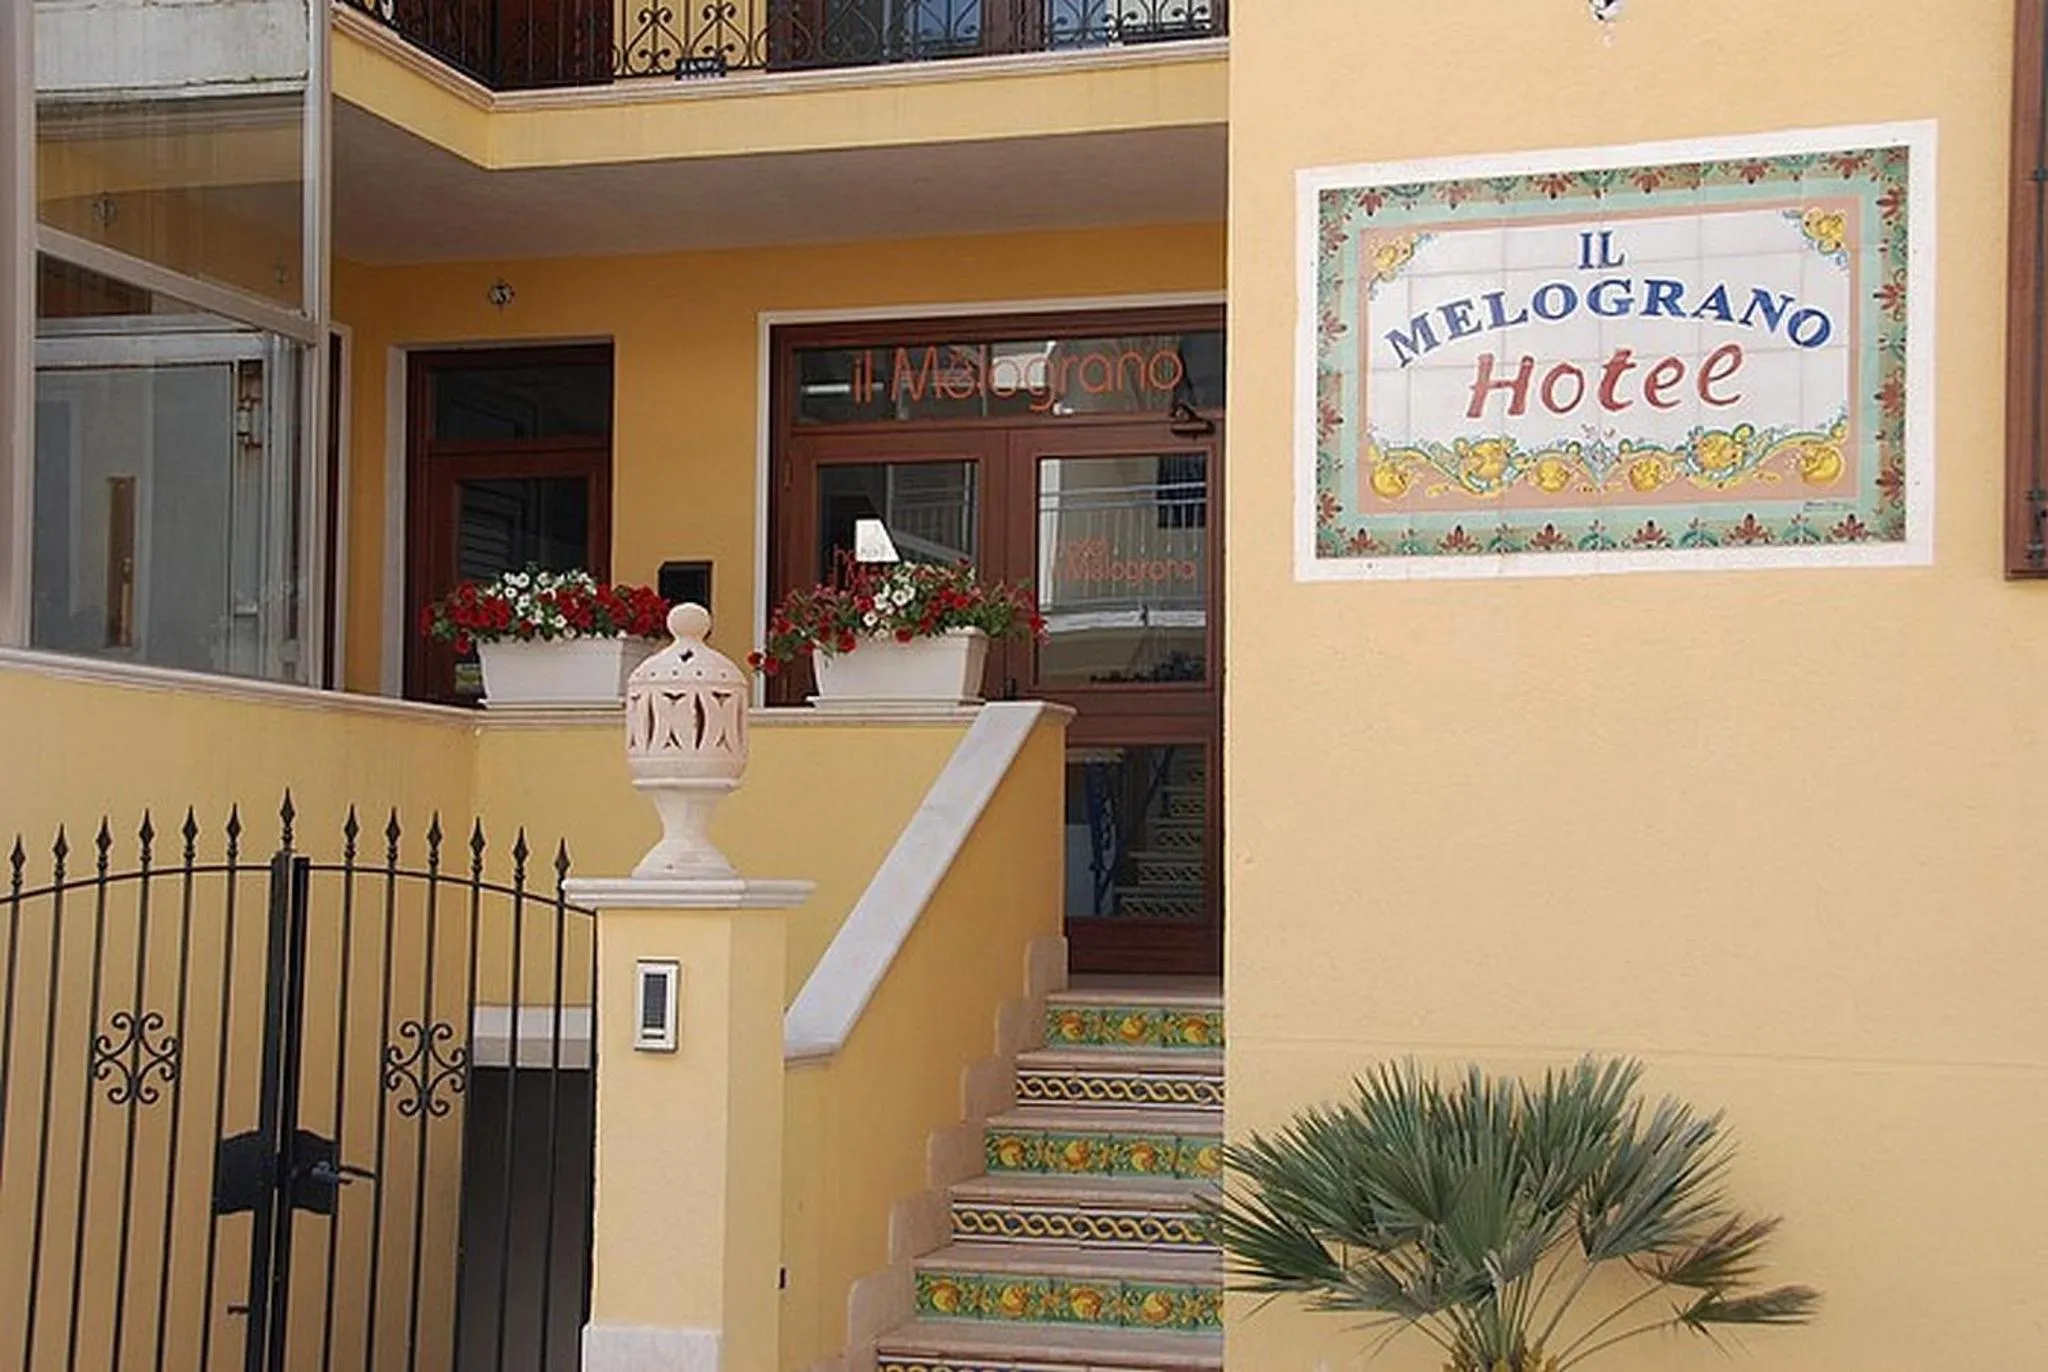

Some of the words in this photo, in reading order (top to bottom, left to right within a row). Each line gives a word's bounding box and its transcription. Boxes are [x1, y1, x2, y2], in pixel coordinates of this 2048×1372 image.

[1577, 229, 1626, 270] IL
[1383, 277, 1832, 367] MELOGRANO
[853, 349, 872, 404] il
[890, 343, 1184, 413] Melograno
[1465, 343, 1745, 419] Hotel
